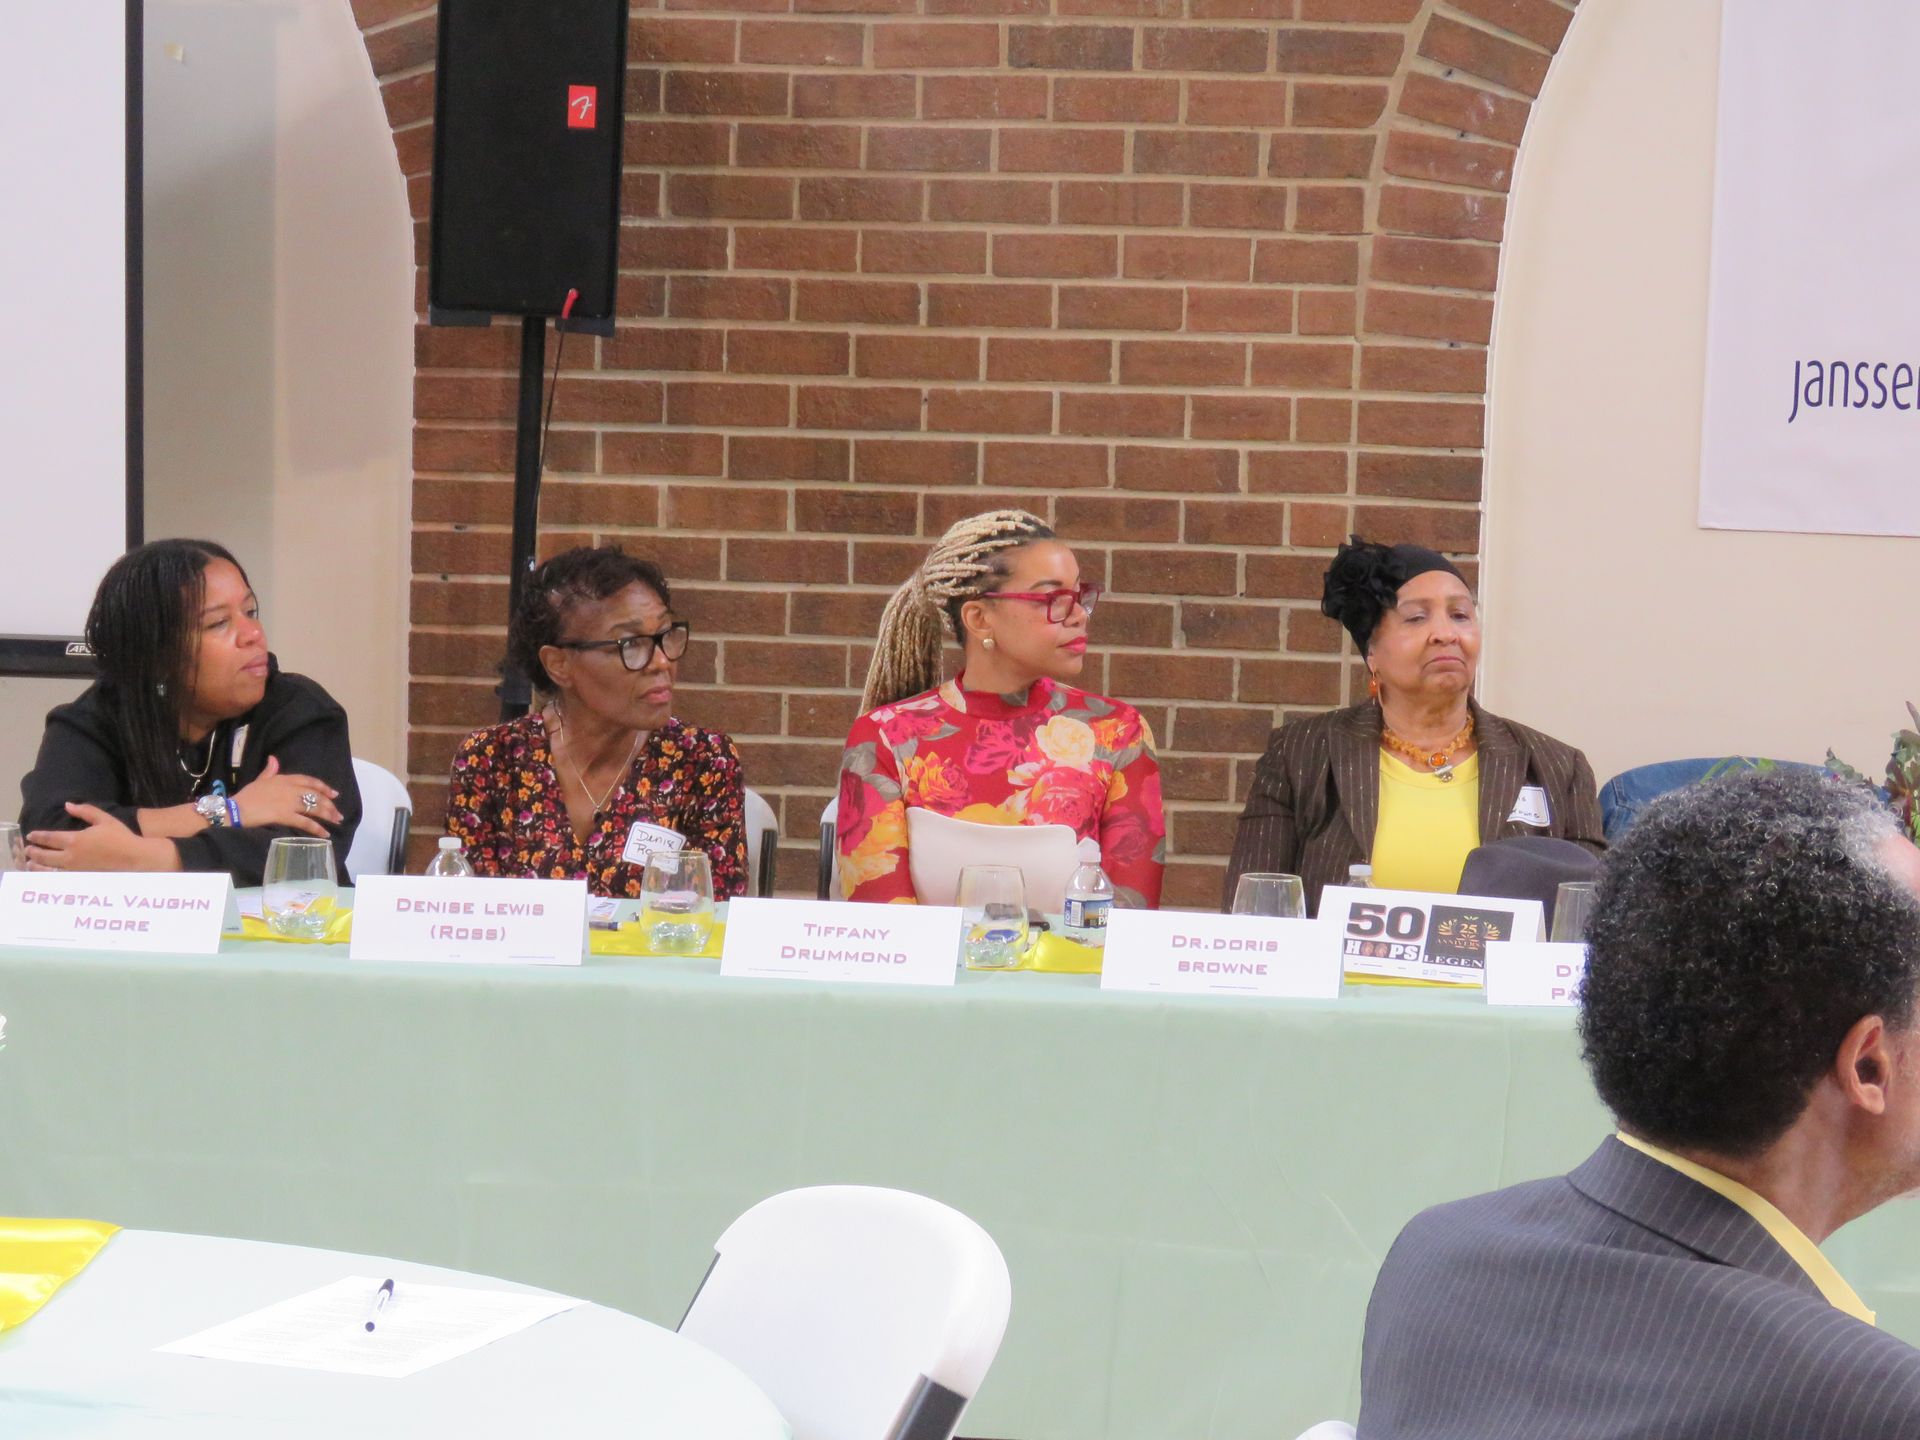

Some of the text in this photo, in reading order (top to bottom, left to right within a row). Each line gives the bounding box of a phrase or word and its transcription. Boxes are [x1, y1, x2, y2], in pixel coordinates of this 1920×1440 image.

[1346, 902, 1426, 942] 50
[1460, 923, 1478, 934] 25
[1423, 954, 1484, 968] LEGEN
